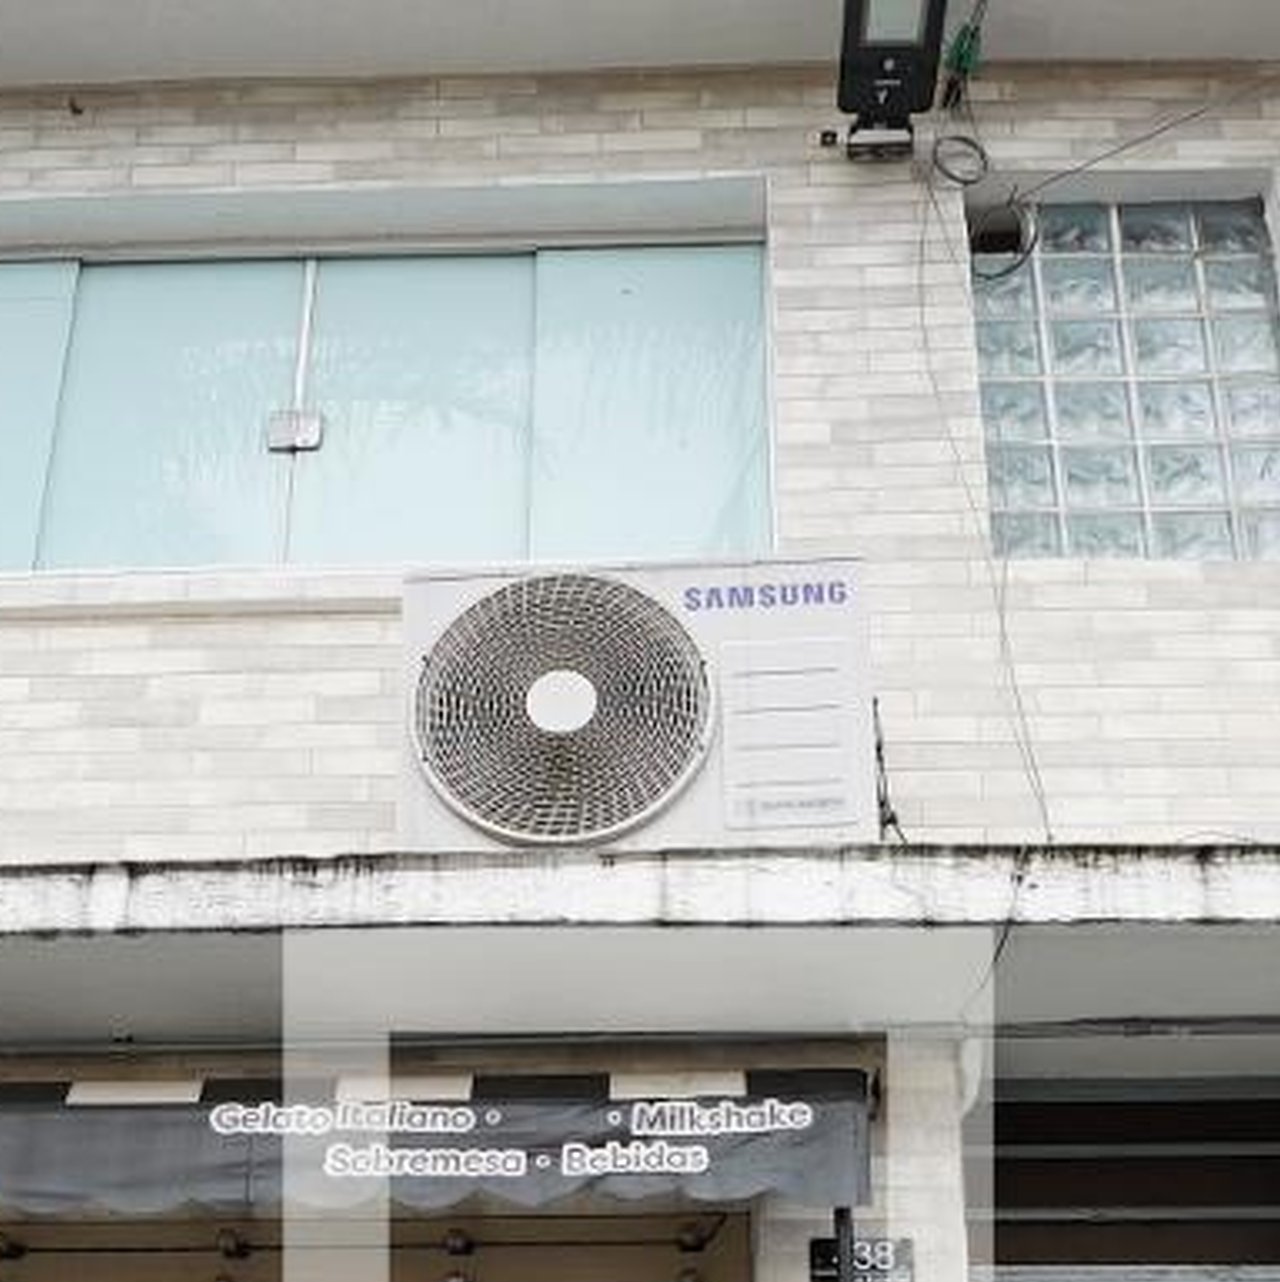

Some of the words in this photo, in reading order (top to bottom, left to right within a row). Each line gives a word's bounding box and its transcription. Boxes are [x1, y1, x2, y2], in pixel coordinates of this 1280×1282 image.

[684, 581, 847, 611] SAMSUNG
[213, 1103, 332, 1132] Gelato
[337, 1101, 474, 1131] Italiano
[633, 1102, 810, 1134] Milkshake
[327, 1146, 524, 1174] Sobremesa
[565, 1146, 707, 1173] Bebidas
